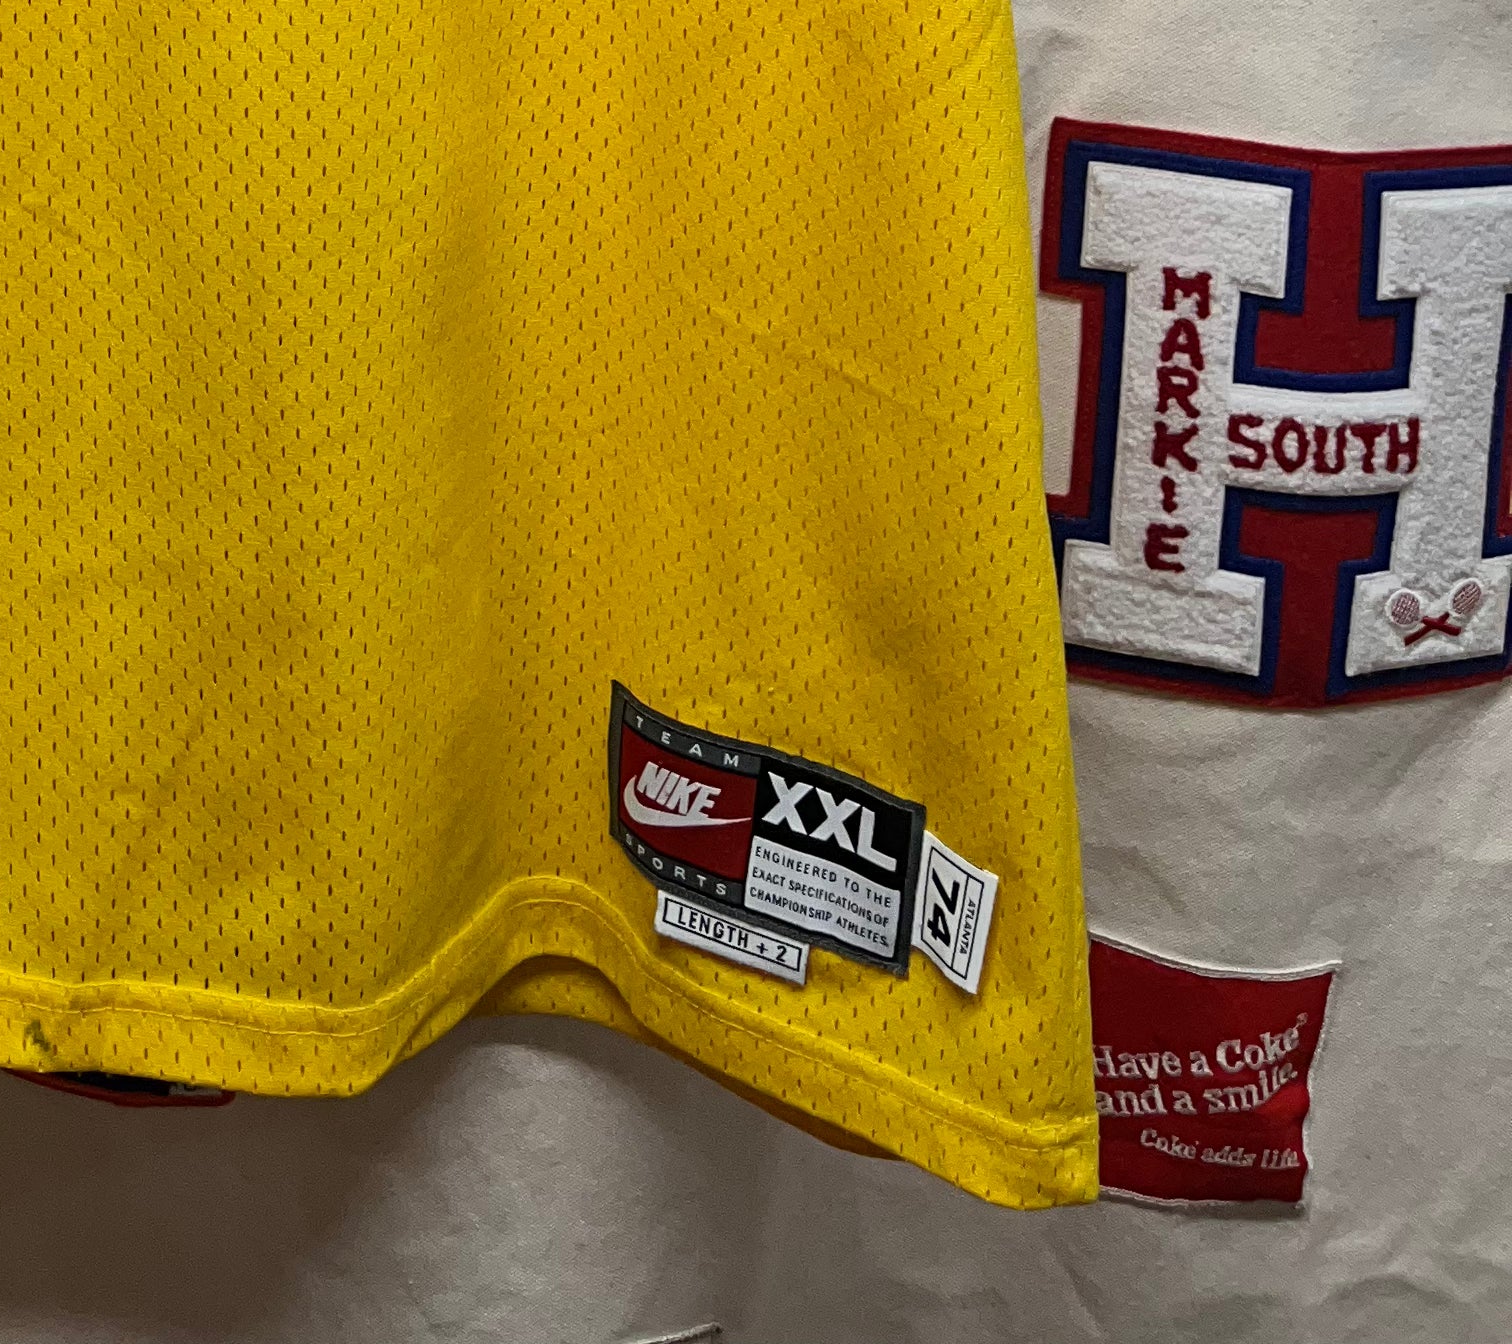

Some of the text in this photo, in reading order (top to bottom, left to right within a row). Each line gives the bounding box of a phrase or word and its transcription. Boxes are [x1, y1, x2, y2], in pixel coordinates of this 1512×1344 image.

[1143, 266, 1213, 574] MARKIE
[1226, 414, 1420, 476] SOUTH
[636, 715, 739, 768] TEAM
[637, 761, 722, 818] NIKE
[761, 771, 897, 872] XXL
[625, 832, 727, 896] SPORTS
[755, 846, 891, 908] ENGINEERED TO THE
[749, 887, 832, 922] CHAMPIONSHIP
[752, 867, 786, 887] EXACT
[789, 880, 872, 922] SPECIFICATIONS
[927, 867, 960, 947] 74
[677, 906, 749, 949] LENGTH
[776, 945, 788, 962] 2
[959, 897, 976, 955] ATLANTA
[1093, 1045, 1182, 1080] Have
[1189, 1050, 1214, 1077] a
[1095, 1083, 1168, 1117] and
[1172, 1090, 1198, 1115] a
